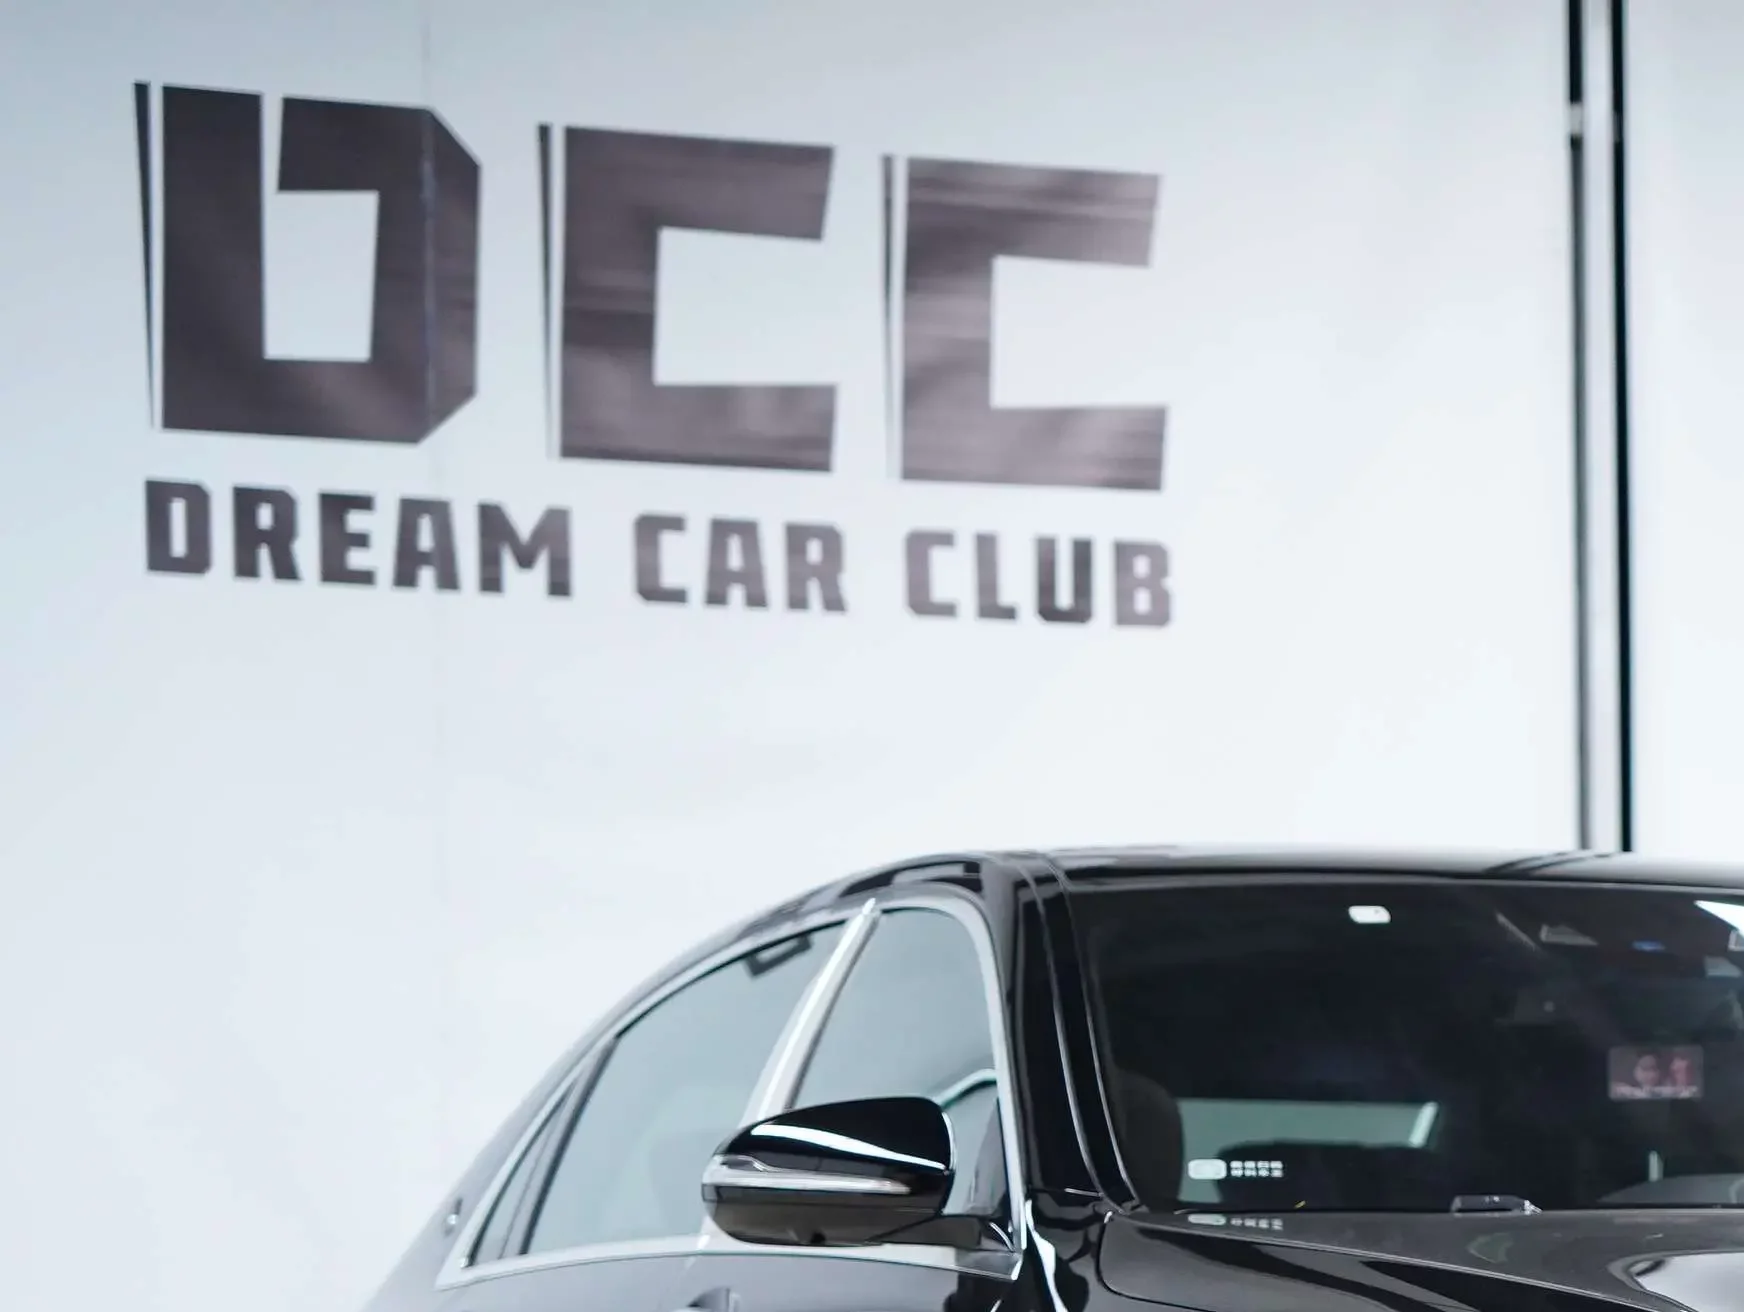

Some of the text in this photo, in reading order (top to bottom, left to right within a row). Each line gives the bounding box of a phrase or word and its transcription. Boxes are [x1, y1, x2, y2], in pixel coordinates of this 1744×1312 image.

[134, 81, 1169, 492] DCC
[144, 478, 1173, 628] DREAM CAR CLUB
